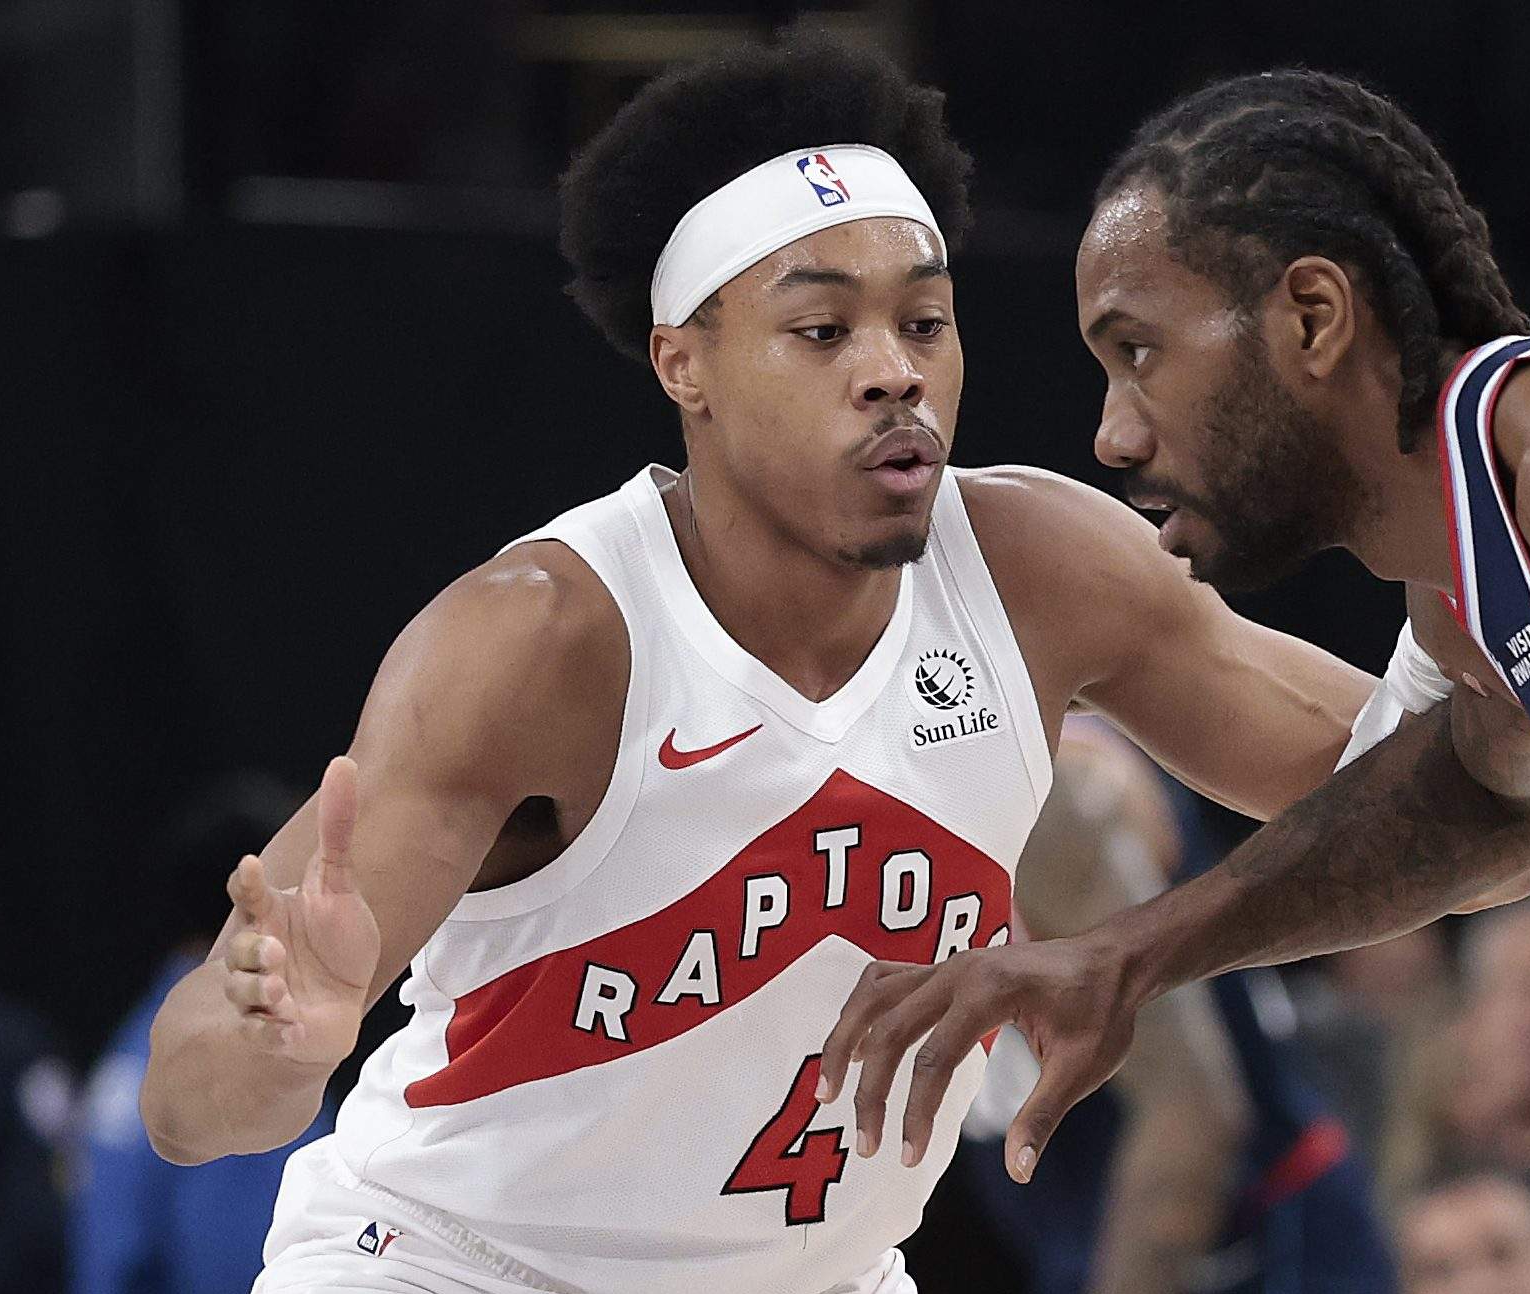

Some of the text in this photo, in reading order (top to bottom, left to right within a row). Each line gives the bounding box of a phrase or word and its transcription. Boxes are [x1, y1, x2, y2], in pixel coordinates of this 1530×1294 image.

[913, 707, 999, 747] Sun Life
[573, 822, 1010, 1043] RAPTOR
[719, 1052, 849, 1226] 4
